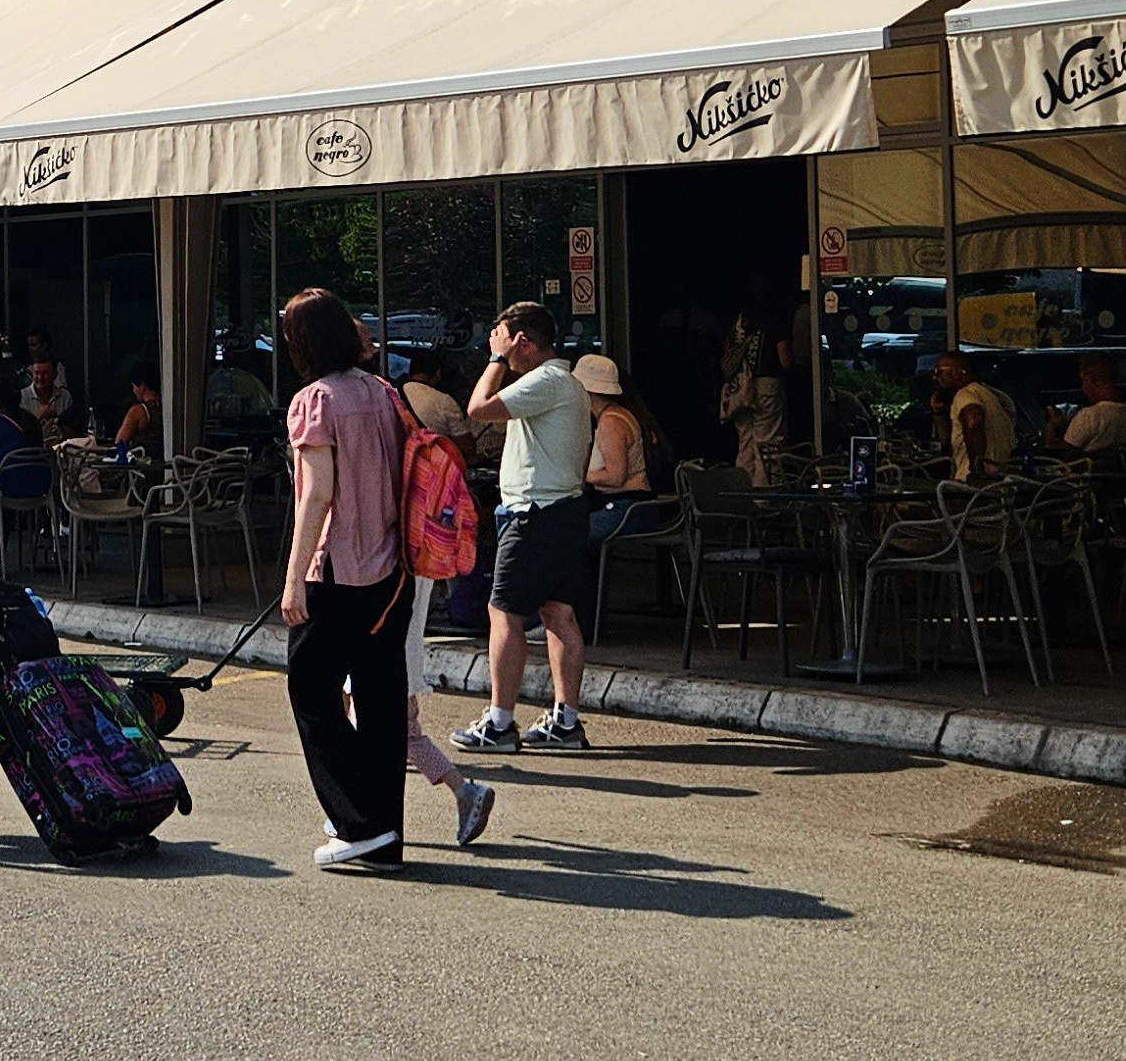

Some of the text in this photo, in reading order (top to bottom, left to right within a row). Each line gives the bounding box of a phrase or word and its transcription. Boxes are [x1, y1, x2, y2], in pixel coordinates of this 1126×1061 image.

[316, 131, 343, 149] cafe
[313, 150, 349, 165] negro
[18, 682, 57, 717] PARIS
